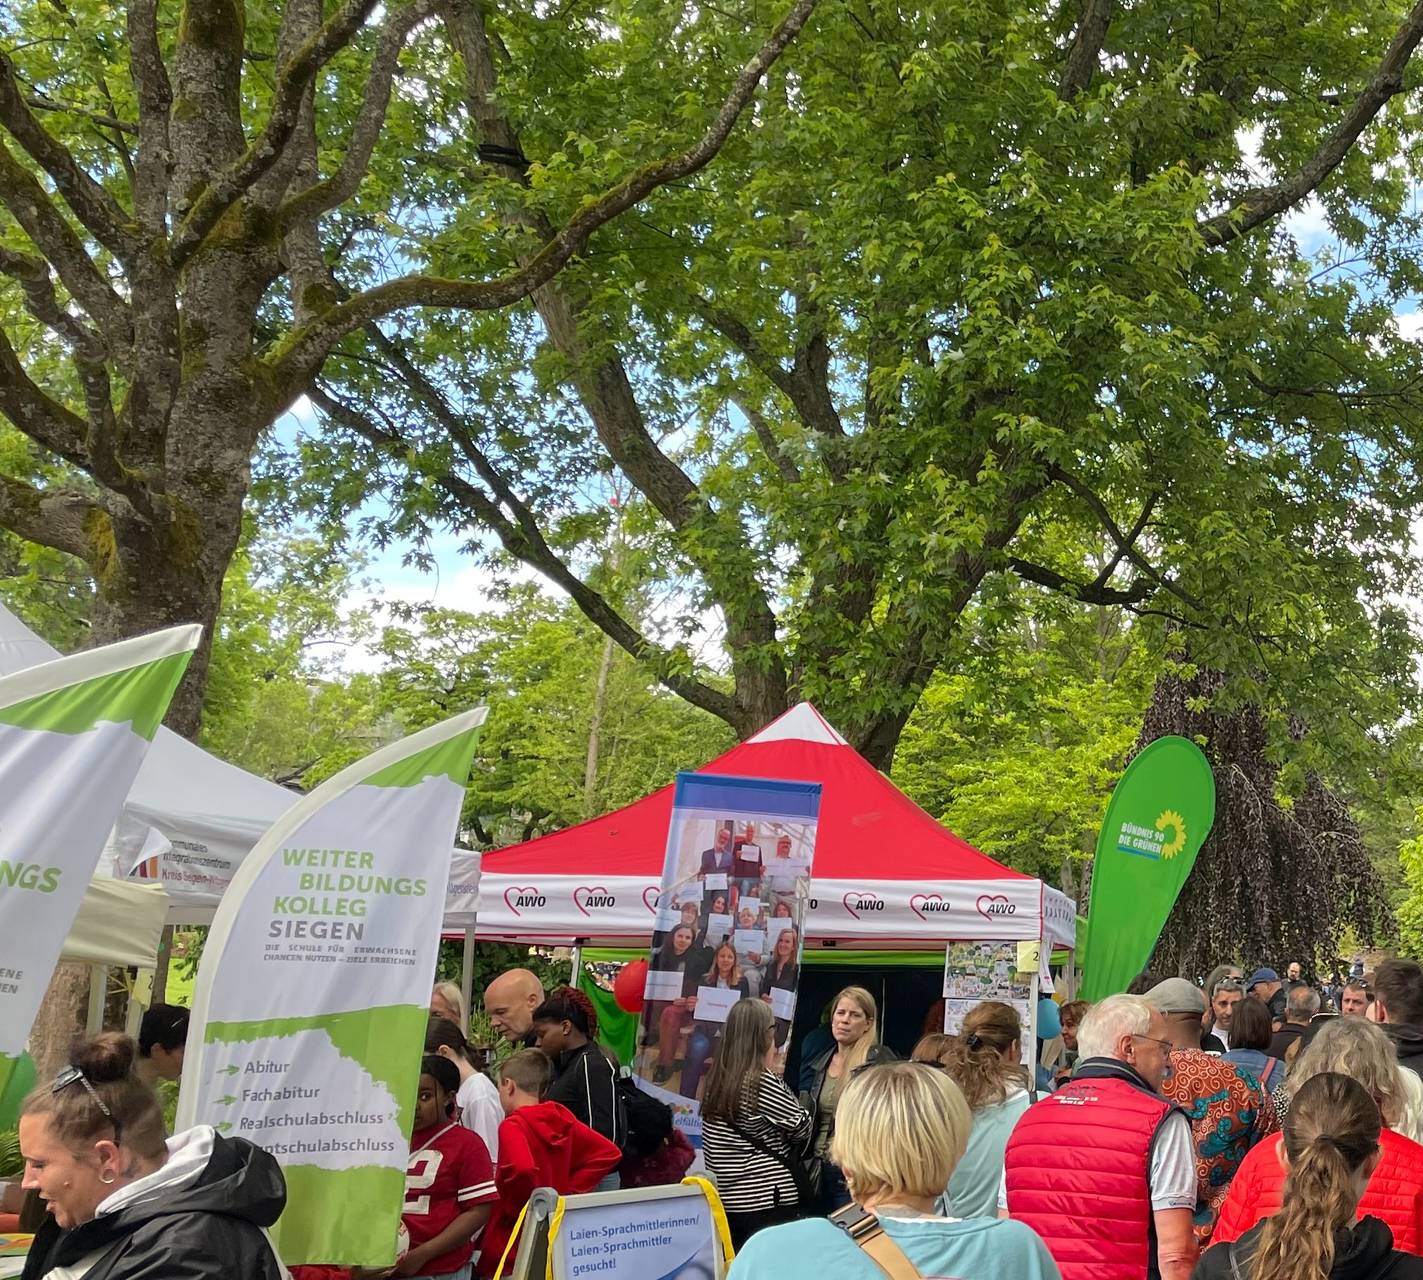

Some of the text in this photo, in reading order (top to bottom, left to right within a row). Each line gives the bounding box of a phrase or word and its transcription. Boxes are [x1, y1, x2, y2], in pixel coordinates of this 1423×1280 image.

[1121, 822, 1165, 842] BÜNDNIS 90
[1118, 834, 1163, 853] DIE GRÜNEN
[282, 849, 375, 869] WEITER
[300, 873, 428, 896] BILDUNGS
[272, 896, 367, 917] KOLLEG
[515, 896, 547, 907] AWO
[585, 896, 616, 907] AWO
[855, 899, 885, 911] AWO
[921, 901, 951, 912] AWO
[986, 903, 1017, 915] AWO
[268, 920, 365, 941] SIEGEN
[288, 944, 322, 952] SCHULE
[328, 944, 345, 953] FÜR
[353, 946, 417, 956] ERWACHSENE
[305, 954, 337, 962] NUTZEN
[370, 956, 416, 966] ERREICHEN
[244, 1061, 290, 1074] Abitur
[242, 1087, 320, 1102] Fachabitur
[239, 1111, 384, 1131] Realschulabschluss
[570, 1214, 701, 1240] Laien-Sprachmittlerinnen/
[571, 1236, 673, 1257] Laien-Sprachmittler
[572, 1258, 617, 1277] gesucht!
